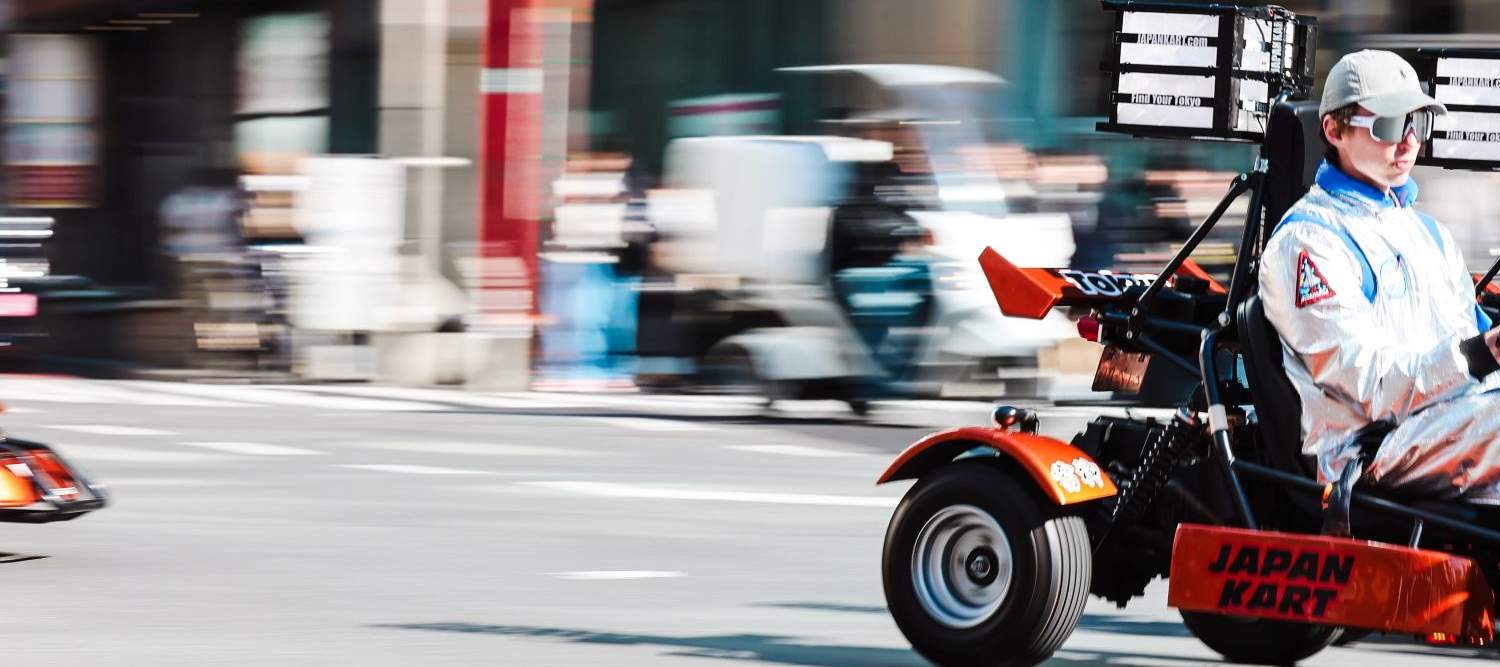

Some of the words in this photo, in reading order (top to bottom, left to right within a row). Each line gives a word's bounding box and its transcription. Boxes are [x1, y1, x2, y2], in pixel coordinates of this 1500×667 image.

[1137, 33, 1208, 48] JAPANKART.com
[1131, 93, 1151, 105] Find
[1152, 94, 1173, 106] Your
[1174, 96, 1202, 107] Tokyo
[1464, 131, 1485, 142] Your
[1208, 544, 1355, 584] JAPAN
[1218, 579, 1338, 617] KART
